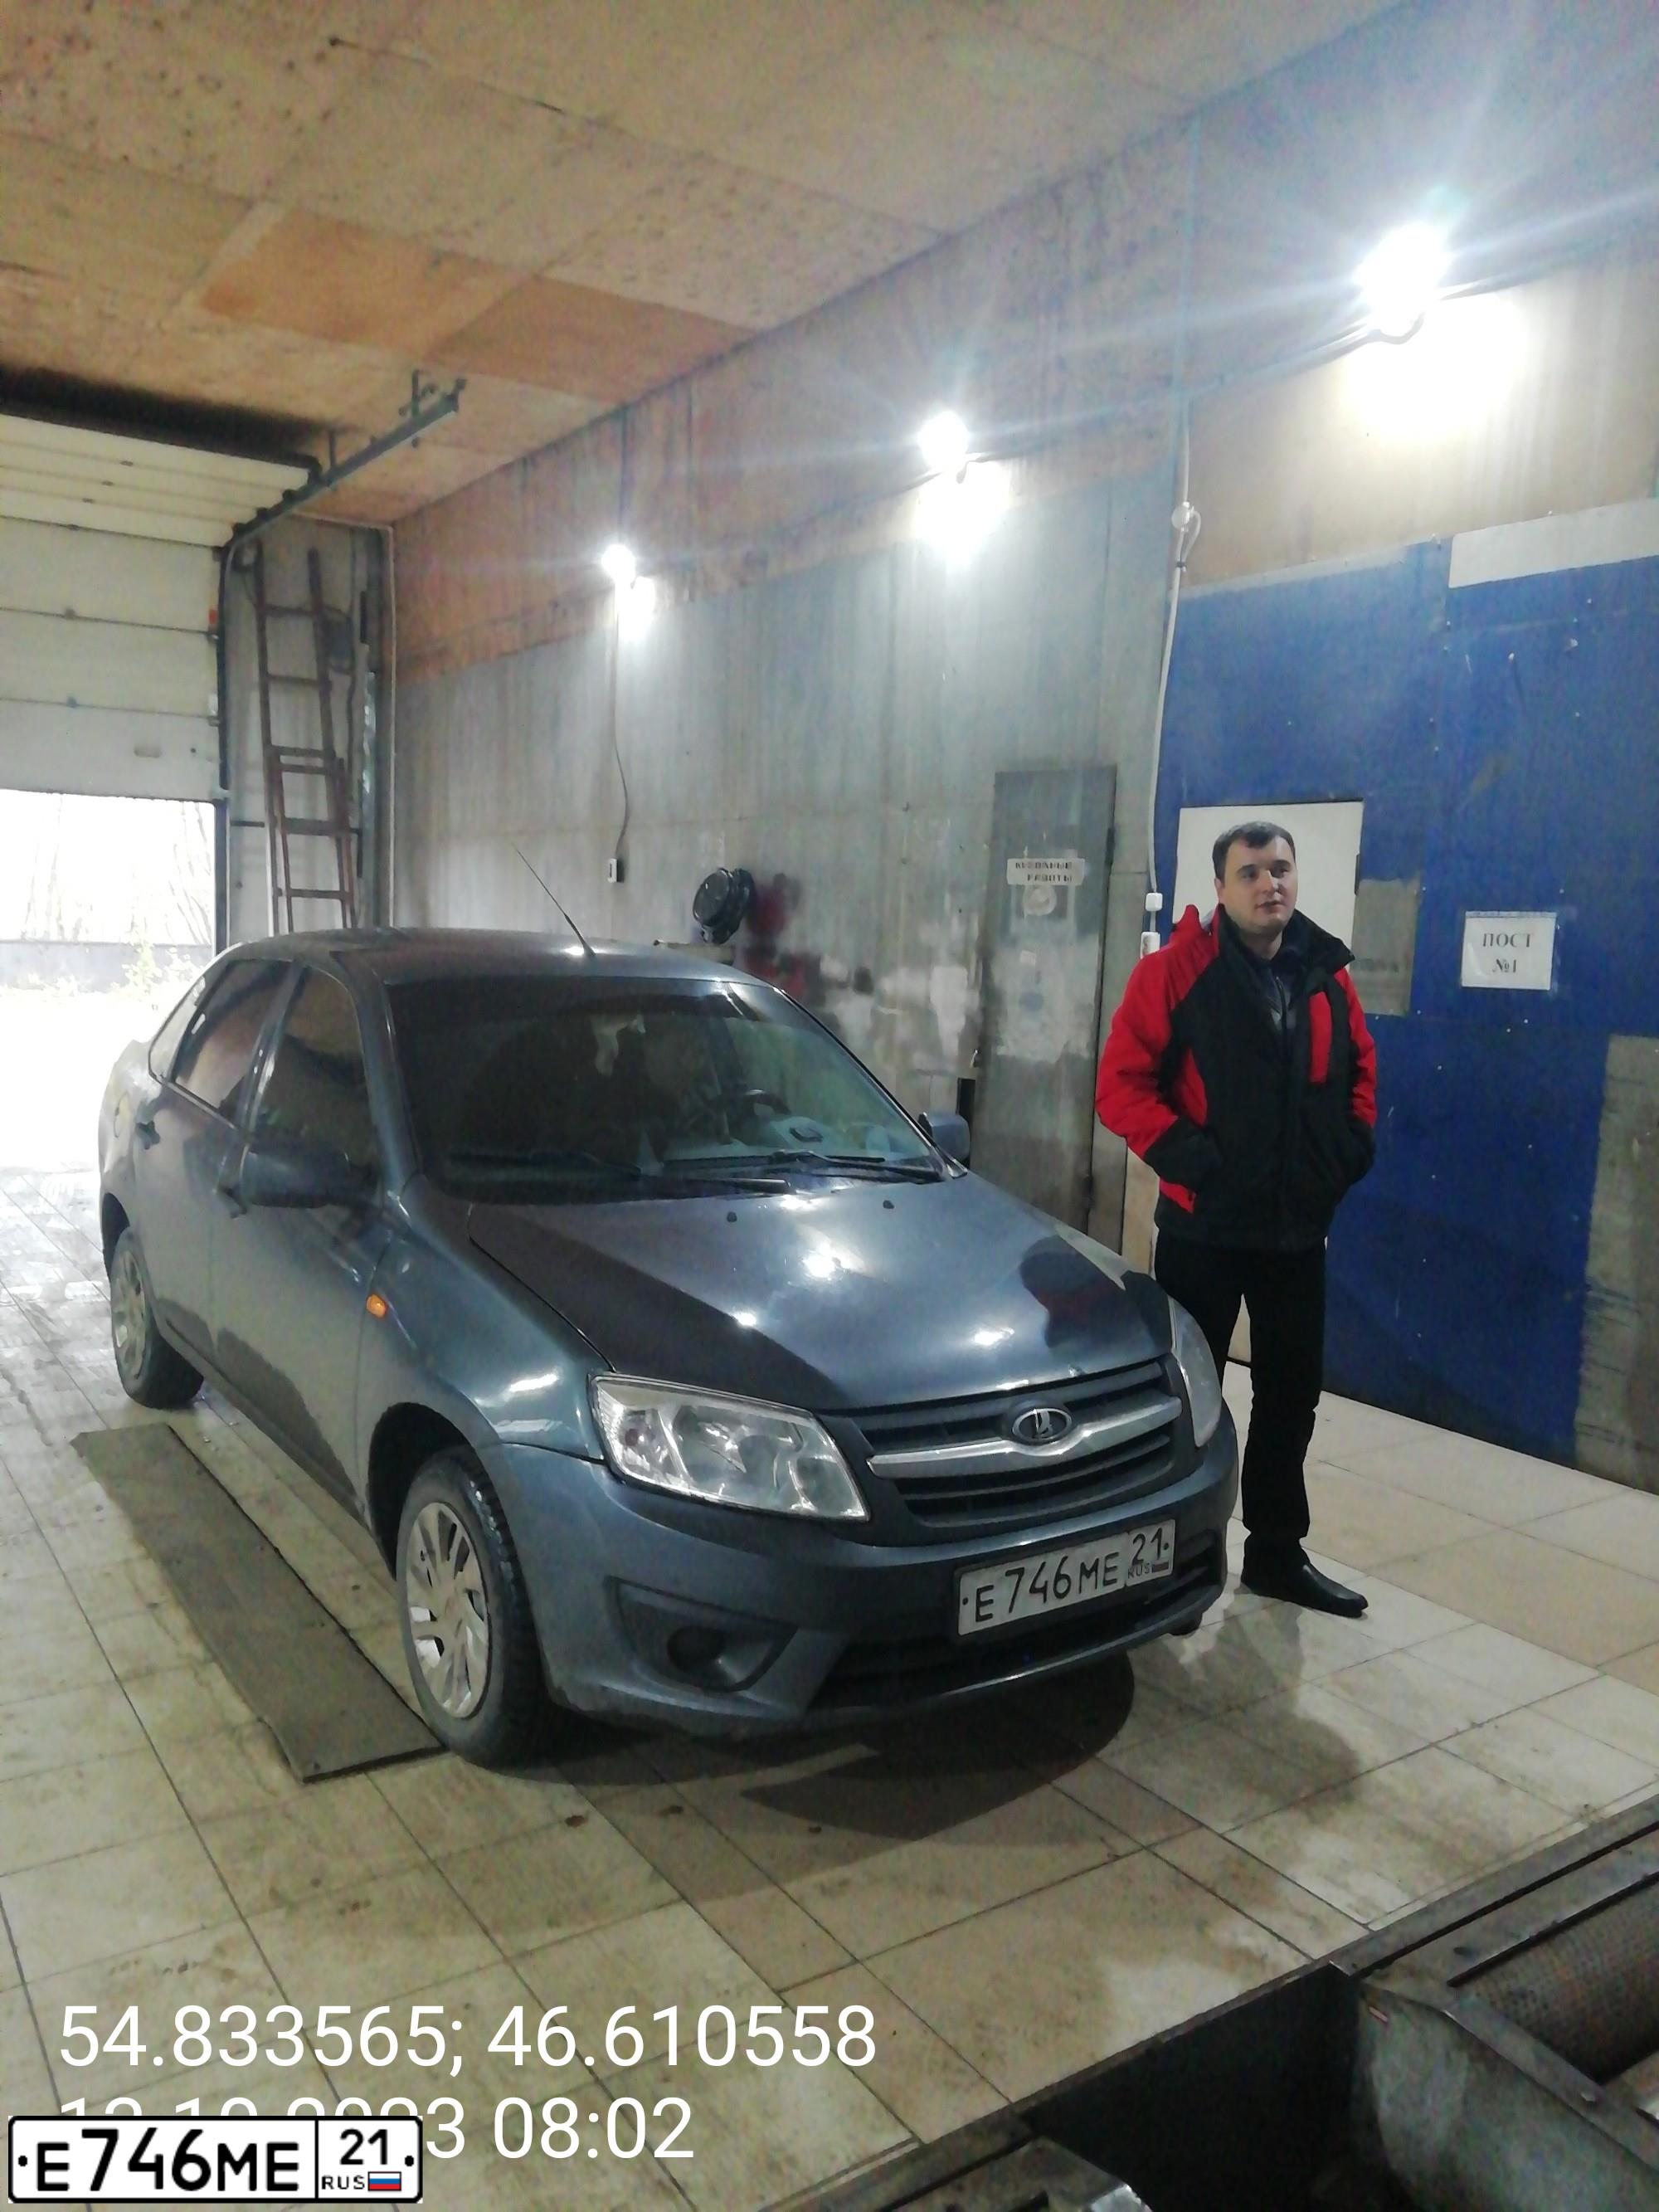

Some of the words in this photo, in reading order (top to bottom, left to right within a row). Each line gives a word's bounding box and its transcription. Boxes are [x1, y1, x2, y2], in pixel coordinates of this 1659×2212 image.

[1482, 933, 1532, 948] ПОСТ
[1492, 958, 1517, 973] №1
[1131, 1527, 1163, 1566] 21
[1127, 1562, 1151, 1580] RUS
